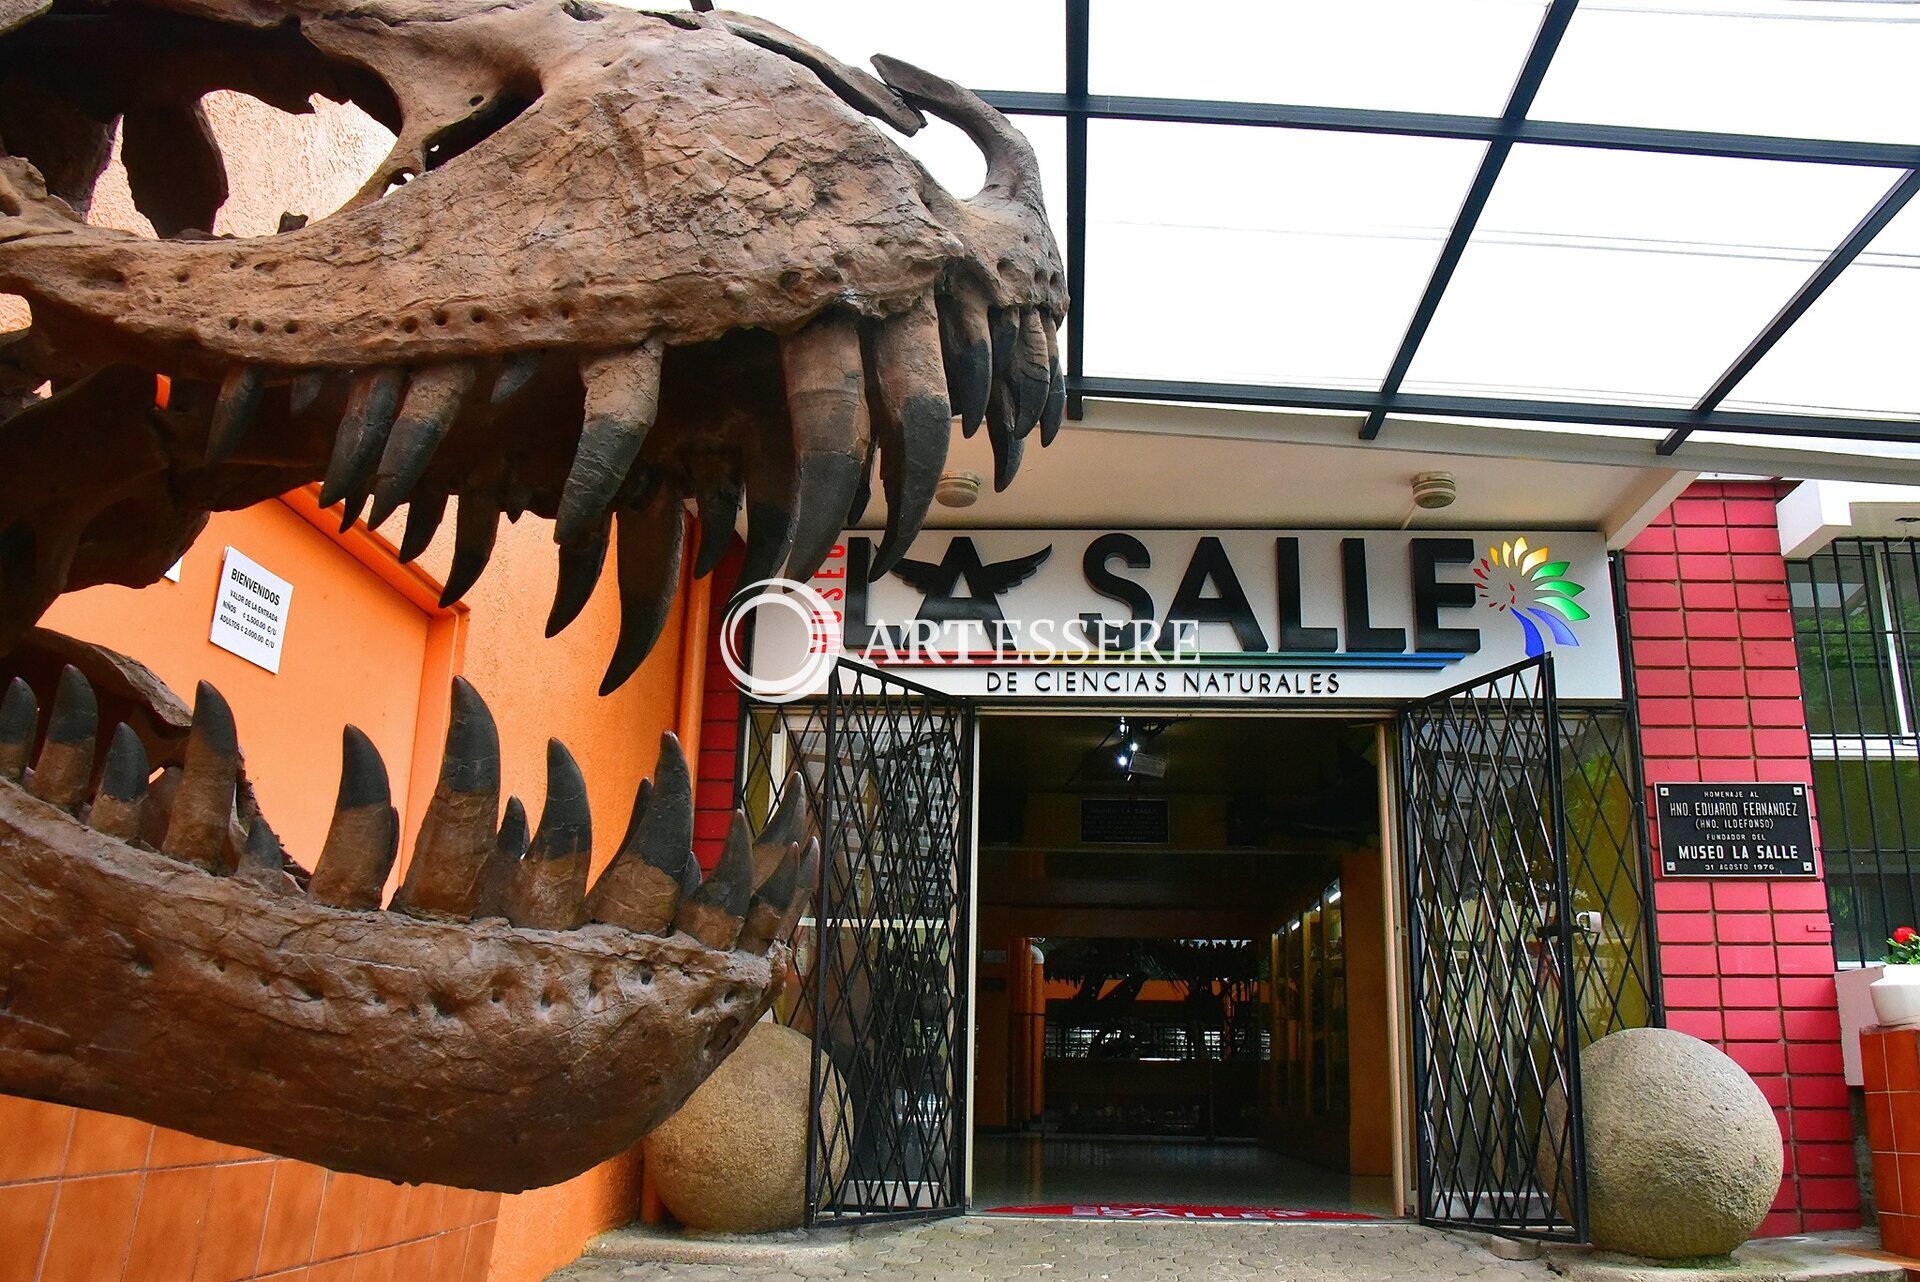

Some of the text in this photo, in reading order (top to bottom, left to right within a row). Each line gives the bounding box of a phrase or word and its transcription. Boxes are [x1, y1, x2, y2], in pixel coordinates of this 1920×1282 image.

[231, 568, 280, 606] BIENVENIDOS
[843, 532, 1481, 653] LA SALLE
[222, 600, 237, 614] NIÑOS
[266, 625, 277, 636] C/U
[230, 589, 278, 622] VALOR DE LA ENTRADA
[220, 614, 240, 631] ADULTOS
[265, 638, 275, 649] C/U
[986, 671, 1340, 694] DE CIENCIAS NATURALES
[1670, 802, 1798, 817] HNO. EDUARDO FERNANDEZ
[1695, 818, 1774, 830] (HNO. ILDEFONSO)
[1706, 833, 1746, 841] FUNDADOR
[1678, 845, 1798, 860] MUSEO LA SALLE
